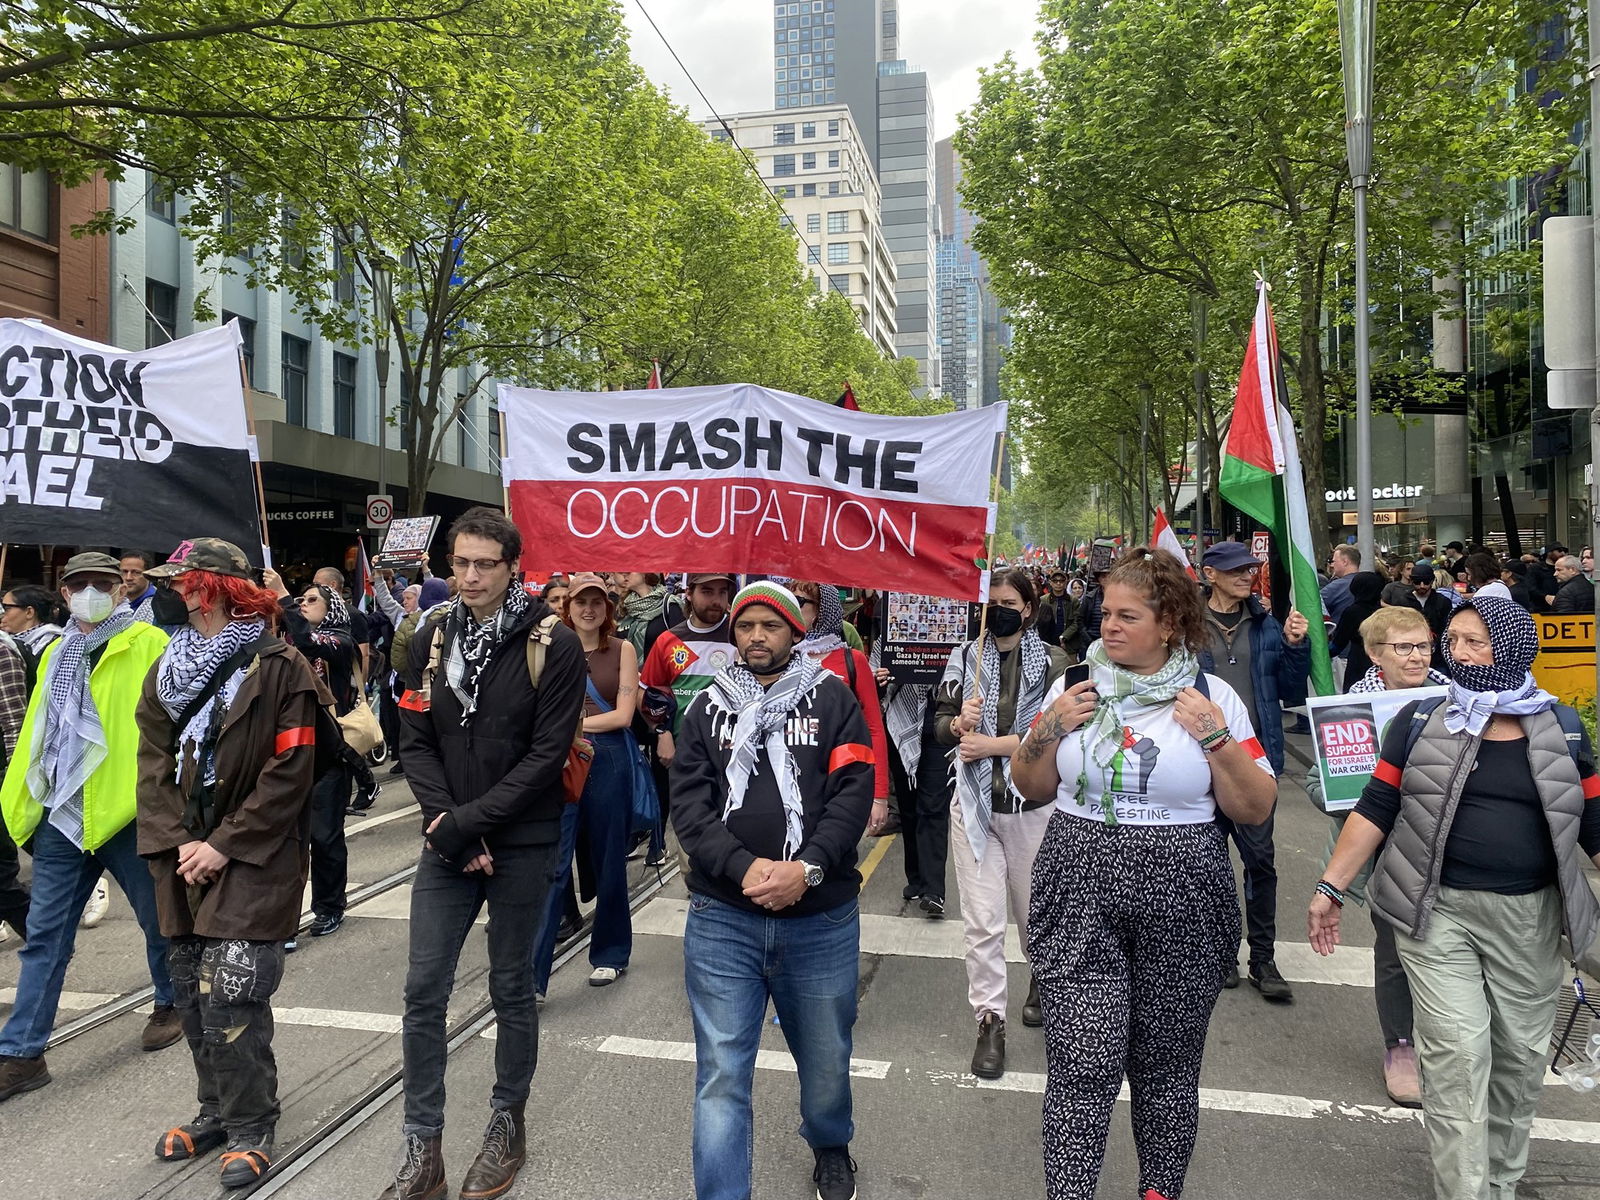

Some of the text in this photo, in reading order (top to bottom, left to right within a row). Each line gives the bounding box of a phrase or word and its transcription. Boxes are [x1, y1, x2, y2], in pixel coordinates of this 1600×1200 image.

[566, 417, 923, 493] SMASH THE
[0, 453, 104, 510] AEL
[1324, 483, 1423, 501] oot ocker
[295, 510, 335, 520] COFFEE
[371, 506, 387, 517] 30
[567, 486, 916, 557] OCCUPATION
[1542, 621, 1594, 640] DET
[912, 652, 921, 661] by
[1323, 722, 1370, 746] END
[1326, 743, 1373, 757] SUPPORT
[1328, 755, 1375, 766] FOR ISRAEL'S
[1329, 763, 1376, 775] WAR CRIMES
[1090, 804, 1171, 820] PAESTINE
